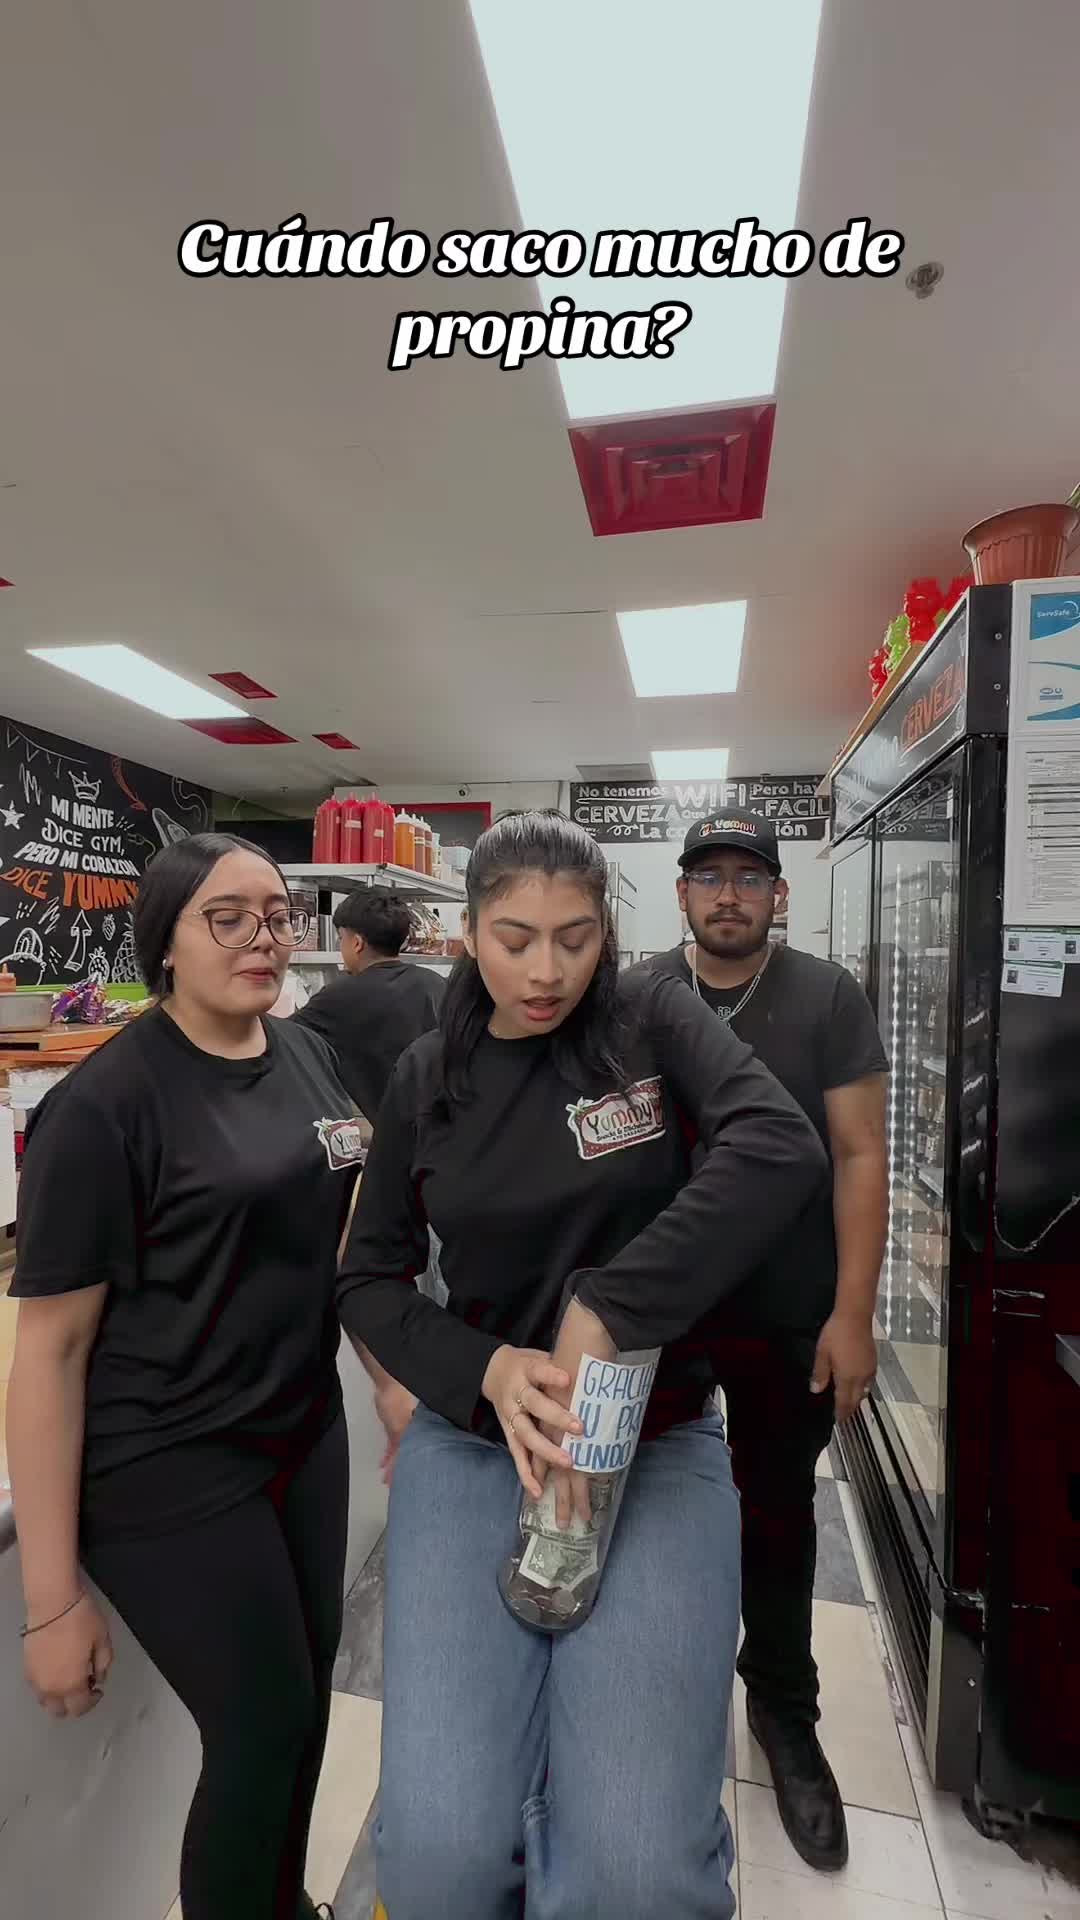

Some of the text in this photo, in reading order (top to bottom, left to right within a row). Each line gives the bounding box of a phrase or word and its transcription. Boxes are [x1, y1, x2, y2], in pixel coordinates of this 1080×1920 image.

[51, 795, 115, 830] MI MENTE
[574, 803, 681, 824] CERVEZA
[765, 799, 833, 817] FACIL
[579, 786, 600, 798] No
[602, 786, 667, 798] tenemos
[674, 783, 747, 808] WIFI
[753, 783, 790, 796] Pero
[91, 835, 126, 856] GYM,
[639, 823, 662, 840] La
[13, 841, 142, 877] PERO MI CORAZON
[0, 866, 140, 911] DICE YUMMY
[586, 1102, 653, 1136] Yummy
[584, 1360, 656, 1401] GRACIA
